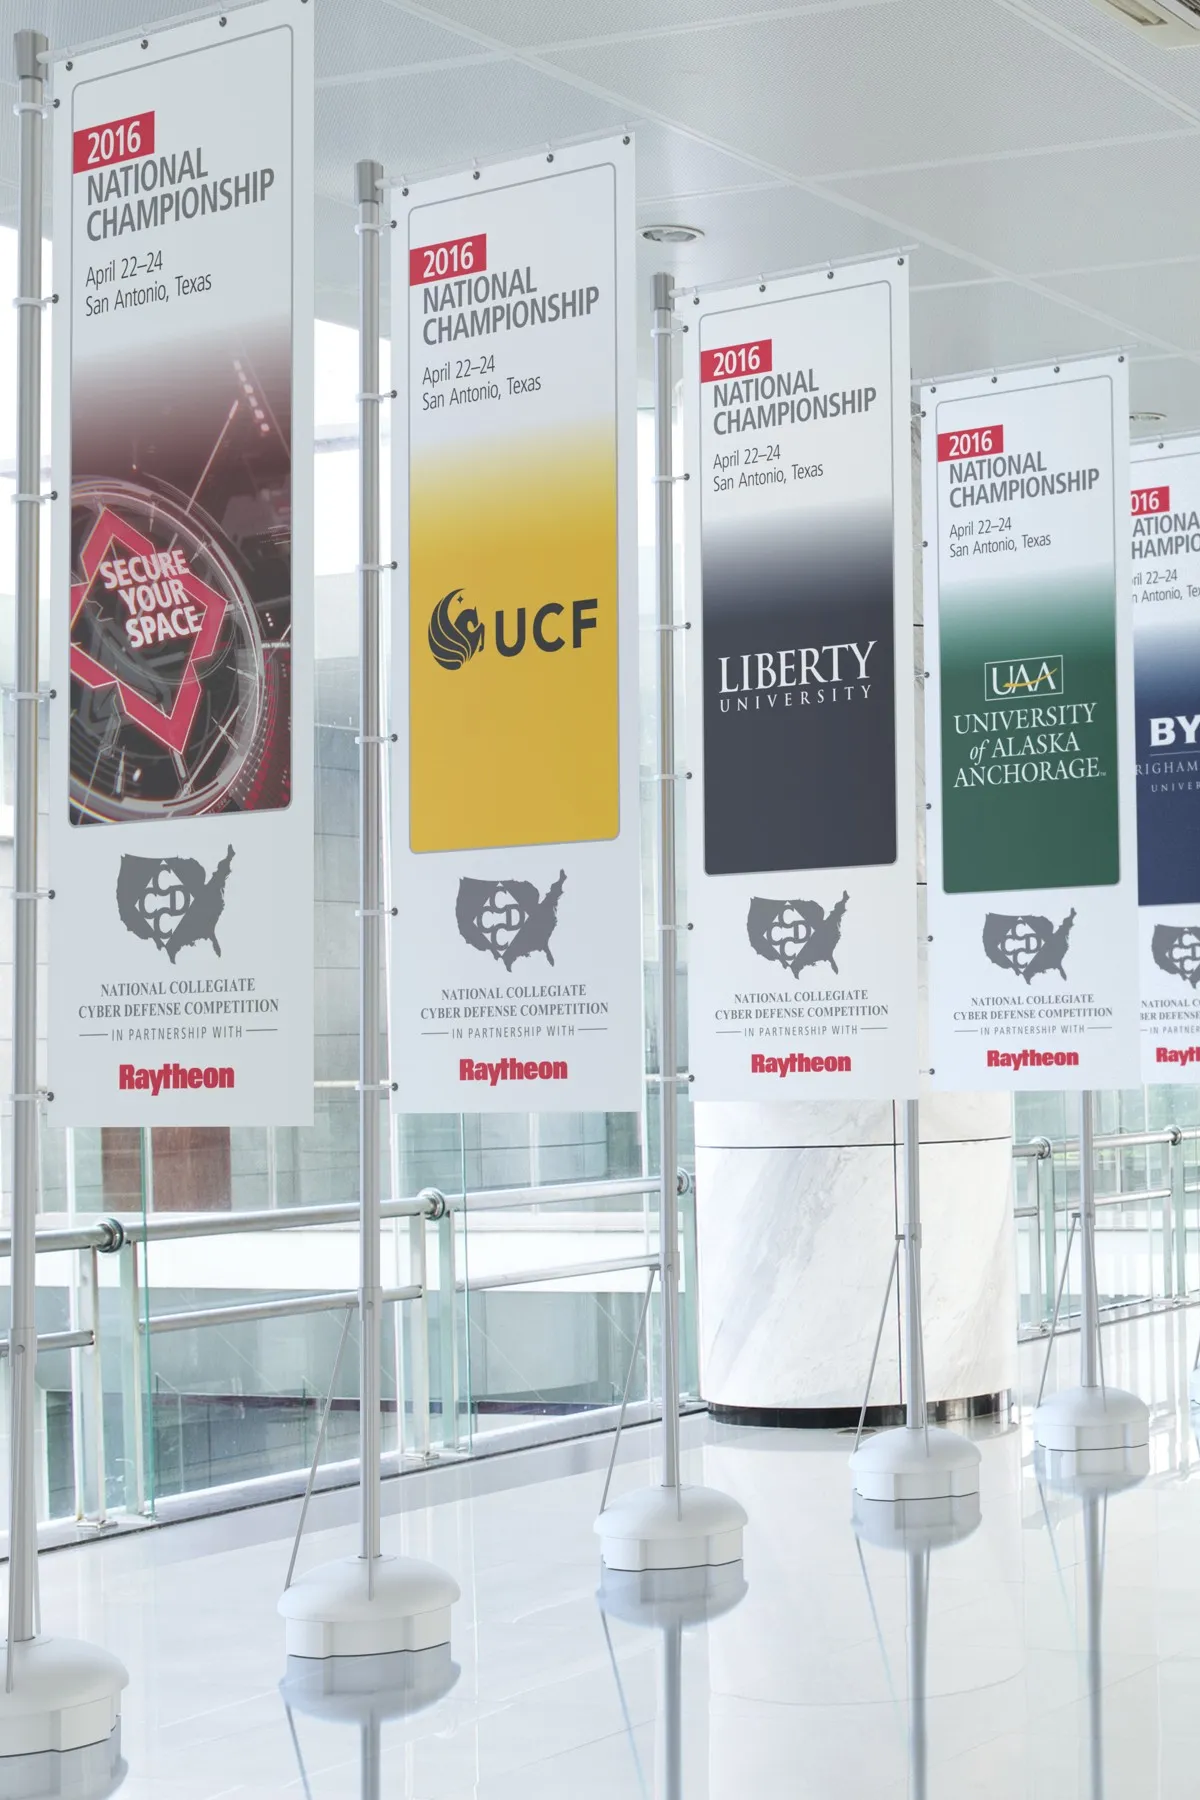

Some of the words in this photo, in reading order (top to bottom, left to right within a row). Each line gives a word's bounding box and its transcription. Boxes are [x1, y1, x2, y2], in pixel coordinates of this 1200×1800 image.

[87, 121, 141, 163] 2016
[88, 147, 208, 205] NATIONAL
[87, 168, 274, 241] CHAMPIONSHIP
[86, 260, 115, 290] April
[121, 251, 163, 279] 22–24
[423, 242, 473, 278] 2016
[86, 296, 108, 316] San
[114, 281, 169, 311] Antonio,
[175, 274, 212, 296] Texas
[424, 267, 537, 314] NATIONAL
[423, 287, 599, 345] CHAMPIONSHIP
[422, 362, 450, 387] April
[456, 355, 495, 379] 22–24
[713, 346, 760, 376] 2016
[422, 392, 444, 410] San
[450, 382, 501, 405] Antonio,
[507, 376, 541, 395] Texas
[714, 369, 819, 408] NATIONAL
[714, 387, 876, 435] CHAMPIONSHIP
[949, 431, 992, 456] 2016
[713, 451, 739, 472] April
[744, 445, 780, 465] 22–24
[950, 451, 1047, 484] NATIONAL
[714, 476, 733, 491] San
[739, 468, 787, 488] Antonio,
[792, 463, 823, 480] Texas
[950, 468, 1099, 508] CHAMPIONSHIP
[1131, 491, 1159, 512] 016
[950, 521, 973, 540] April
[978, 517, 1012, 534] 22–24
[950, 544, 968, 558] San
[973, 537, 1017, 555] Antonio,
[1022, 534, 1051, 548] Texas
[100, 550, 189, 589] SECURE
[1132, 573, 1142, 586] ril
[118, 580, 189, 615] YOUR
[1142, 587, 1183, 602] Antonio,
[126, 607, 202, 647] SPACE
[496, 598, 597, 657] UCF
[718, 640, 877, 693] LIBERTY
[992, 662, 1056, 695] UAA
[720, 685, 871, 712] UNIVERSITY
[953, 702, 1098, 734] UNIVERSITY
[970, 739, 989, 765] of
[992, 732, 1080, 758] ALASKA
[953, 757, 1100, 788] ANCHORAGE
[1136, 760, 1198, 775] RIGHAM
[100, 982, 166, 997] NATIONAL
[170, 978, 255, 994] COLLEGIATE
[442, 987, 503, 1000] NATIONAL
[507, 985, 586, 998] COLLEGIATE
[735, 992, 791, 1004] NATIONAL
[795, 990, 868, 1002] COLLEGIATE
[971, 996, 1023, 1006] NATIONAL
[1026, 994, 1094, 1004] COLLEGIATE
[79, 1005, 120, 1018] CYBER
[124, 1003, 180, 1017] DEFENSE
[185, 999, 279, 1015] COMPETITION
[421, 1008, 460, 1019] CYBER
[464, 1005, 517, 1018] DEFENSE
[520, 1003, 608, 1016] COMPETITION
[715, 1009, 752, 1020] CYBER
[755, 1007, 804, 1019] DEFENSE
[808, 1005, 888, 1017] COMPETITION
[954, 1011, 988, 1020] CYBER
[990, 1010, 1036, 1019] DEFENSE
[1038, 1008, 1112, 1018] COMPETITION
[1141, 1000, 1189, 1008] NATIONAL
[112, 1029, 123, 1041] IN
[129, 1027, 206, 1040] PARTNERSHIP
[213, 1026, 242, 1038] WITH
[452, 1029, 462, 1038] IN
[468, 1026, 541, 1038] PARTNERSHIP
[547, 1025, 575, 1036] WITH
[745, 1028, 754, 1036] IN
[759, 1026, 827, 1036] PARTNERSHIP
[832, 1025, 857, 1034] WITH
[994, 1026, 1056, 1034] PARTNERSHIP
[1061, 1025, 1085, 1033] WITH
[460, 1058, 567, 1086] Raytheon
[752, 1053, 851, 1078] Raytheon
[987, 1050, 1079, 1071] Raytheon
[119, 1064, 234, 1096] Raytheon
